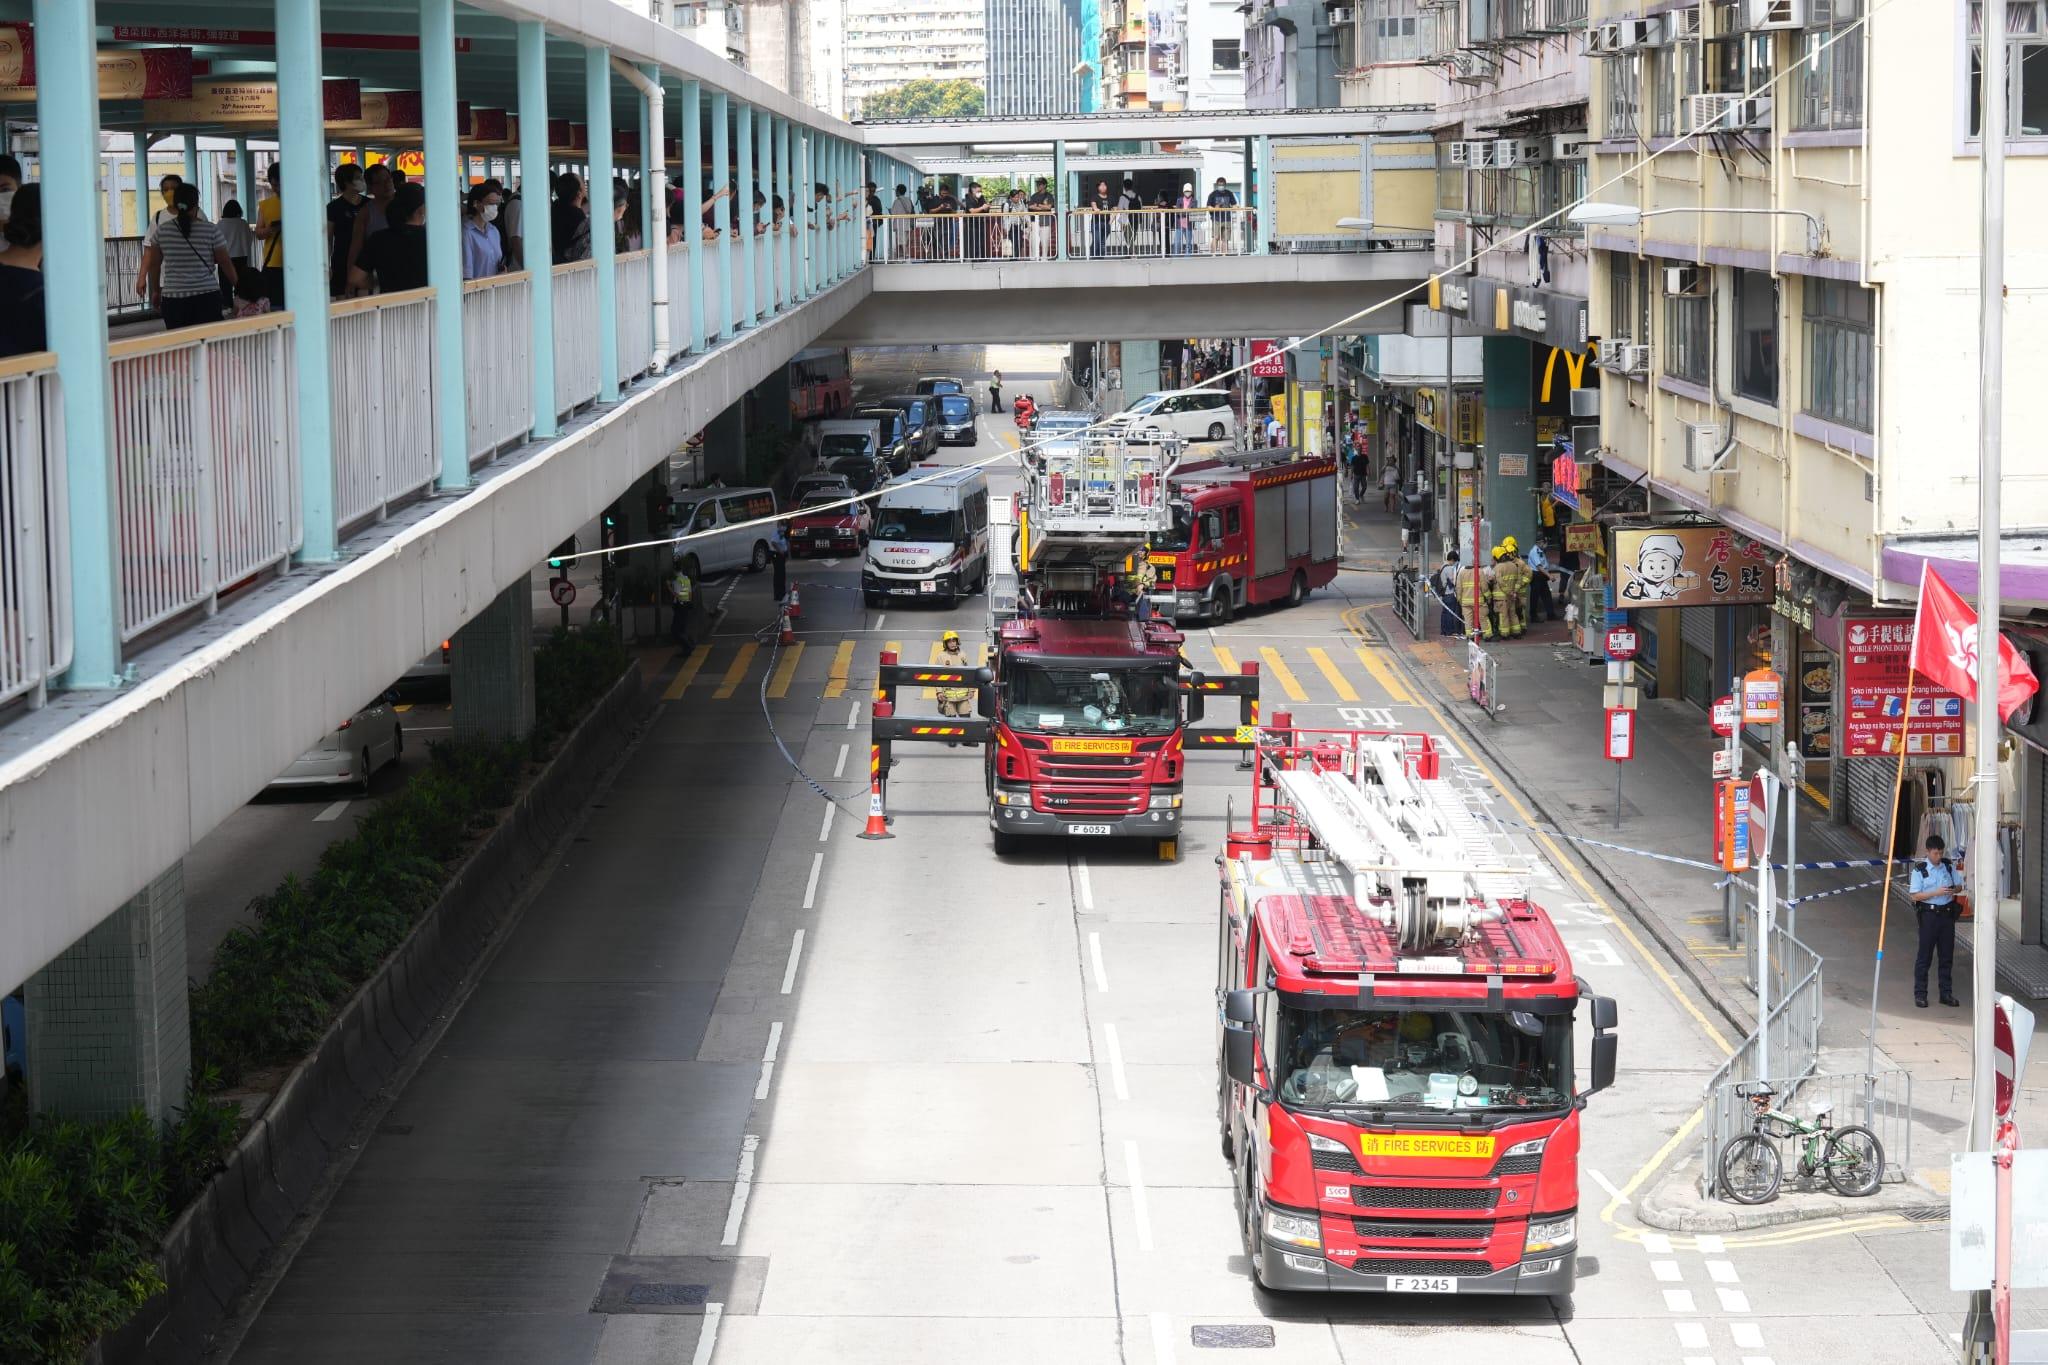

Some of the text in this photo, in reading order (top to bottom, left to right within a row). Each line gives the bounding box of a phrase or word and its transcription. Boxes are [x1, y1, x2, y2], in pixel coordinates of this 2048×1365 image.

[1849, 645, 1872, 653] MOBILE
[1873, 644, 1893, 652] PHONE
[1912, 685, 1929, 695] Orang
[1064, 741, 1081, 750] FIRE
[1083, 742, 1120, 751] SERVICES
[1735, 788, 1748, 801] 793
[1073, 825, 1107, 834] F 6052
[1367, 1138, 1490, 1155] 消 FIRE SERVICES 防
[1395, 1278, 1449, 1291] F 2345
